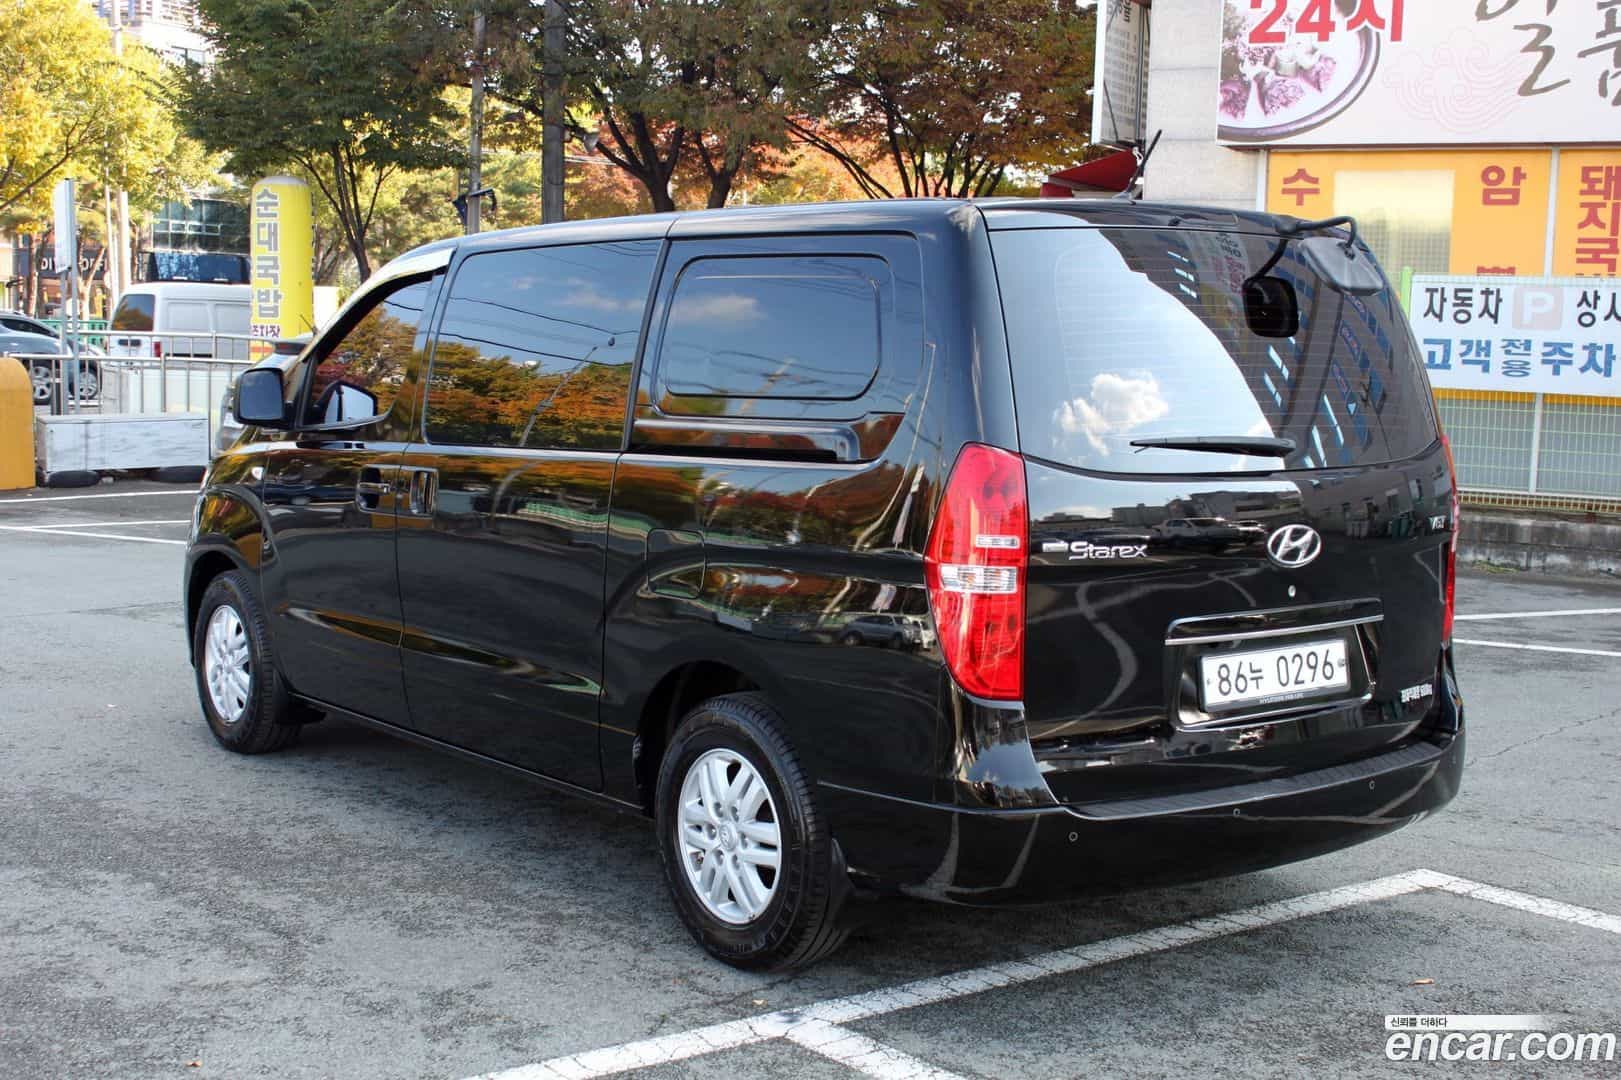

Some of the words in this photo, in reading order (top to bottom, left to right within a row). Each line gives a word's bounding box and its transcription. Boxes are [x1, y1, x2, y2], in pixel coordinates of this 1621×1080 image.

[1248, 0, 1404, 43] 24시
[1575, 165, 1621, 278] 돼지국
[255, 188, 282, 319] 순대국밥
[1423, 287, 1503, 325] 자동차
[1069, 541, 1148, 560] Starex
[1217, 660, 1264, 696] 86누
[1276, 649, 1335, 687] 0296
